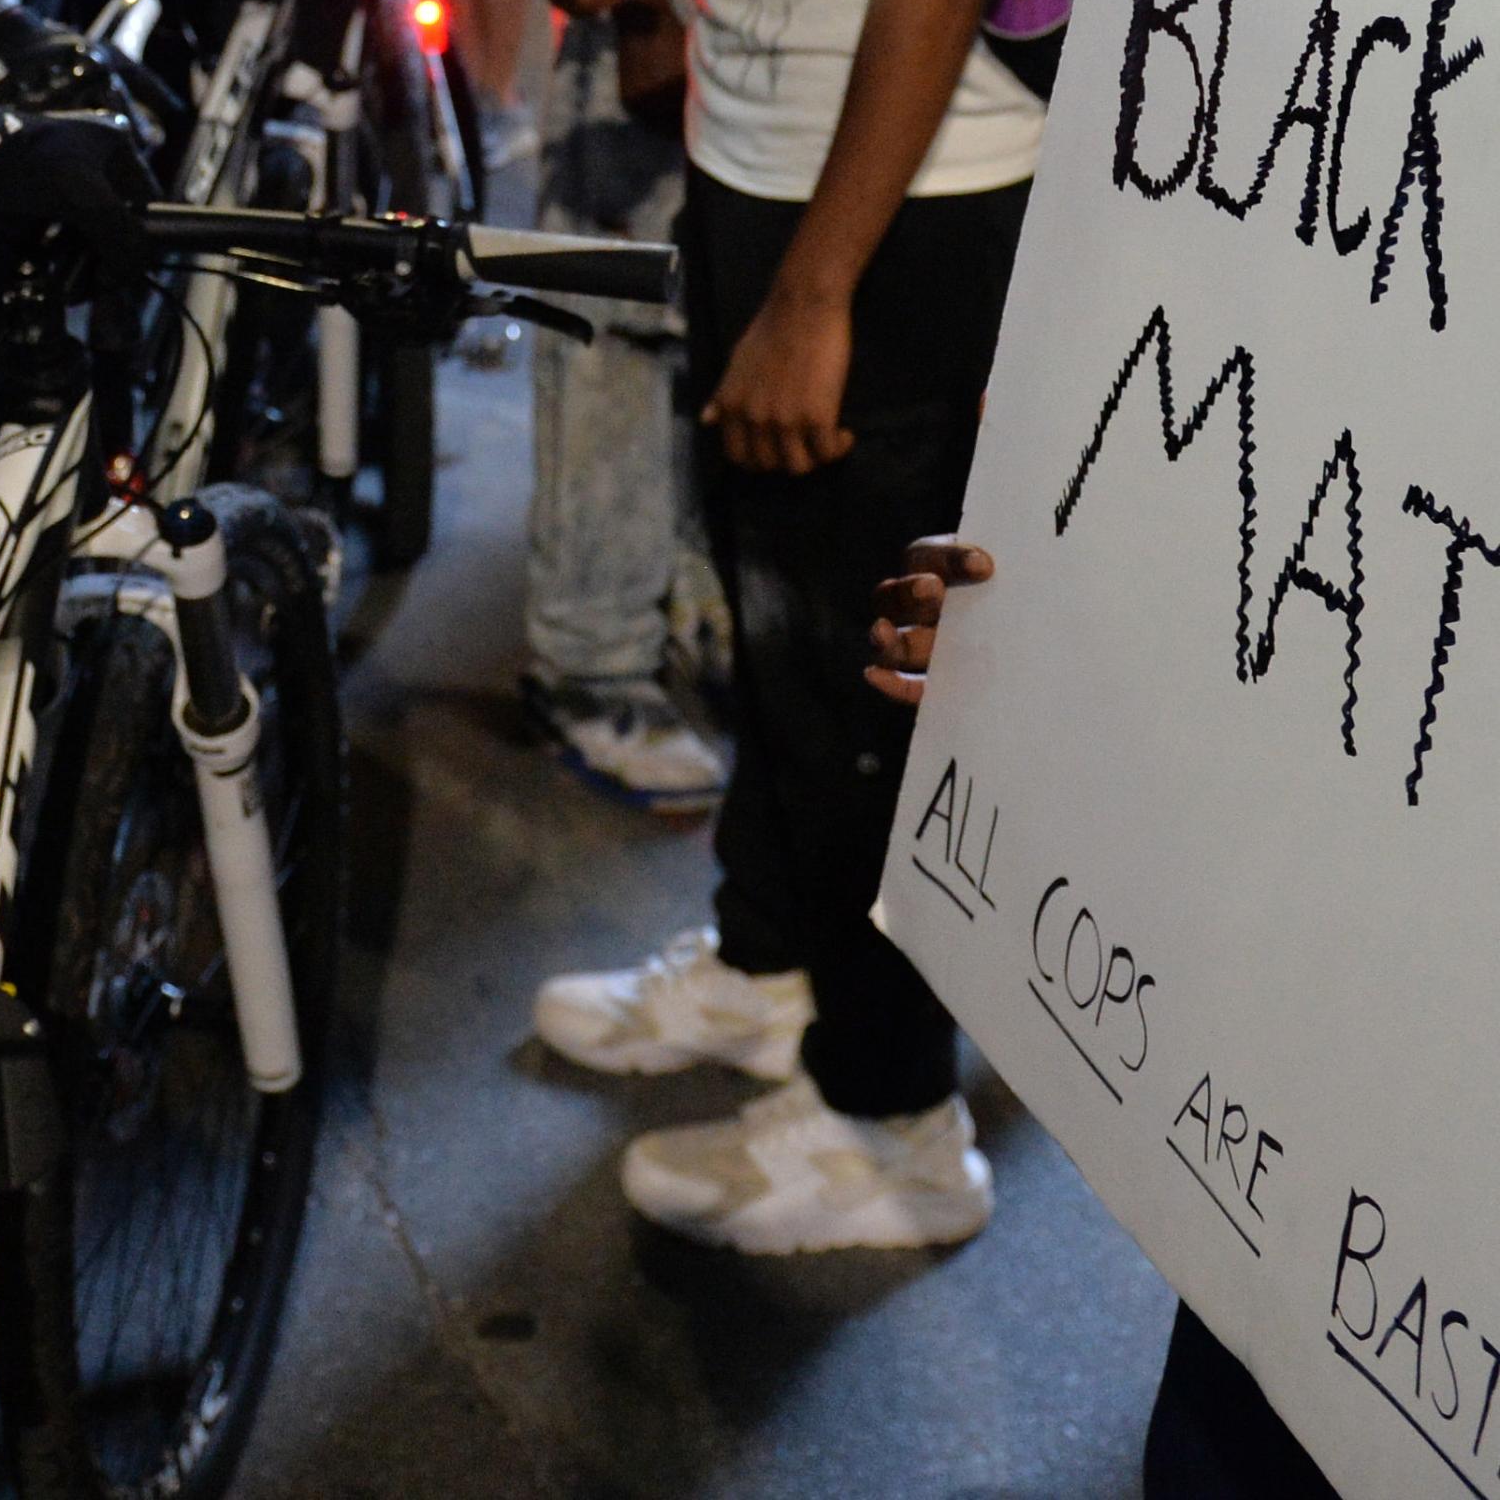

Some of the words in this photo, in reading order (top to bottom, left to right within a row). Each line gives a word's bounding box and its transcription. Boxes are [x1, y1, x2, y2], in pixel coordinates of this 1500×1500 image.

[915, 757, 998, 911] ALL
[1032, 876, 1156, 1072] COPS
[1174, 1072, 1284, 1222] ARE
